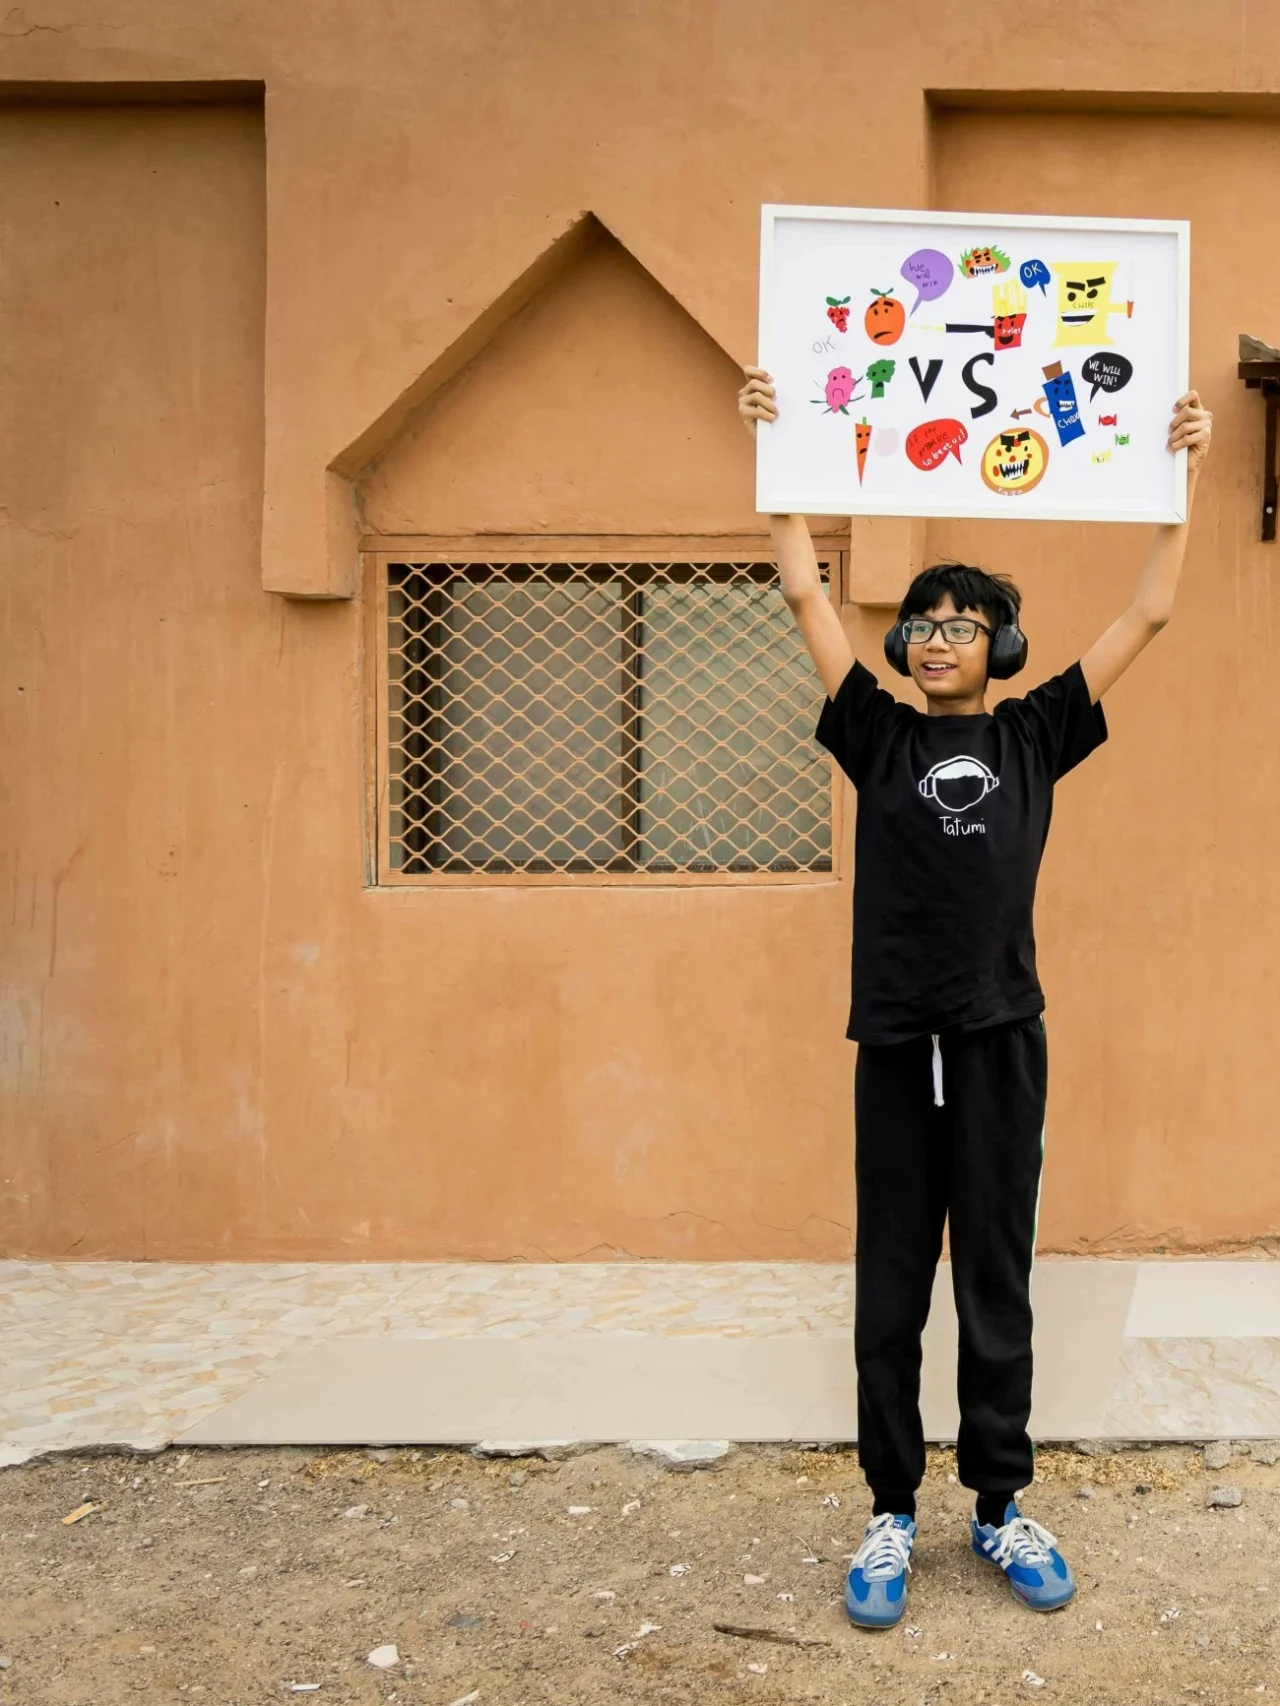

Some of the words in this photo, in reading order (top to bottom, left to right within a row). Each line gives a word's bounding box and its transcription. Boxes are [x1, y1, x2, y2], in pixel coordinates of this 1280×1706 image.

[1088, 359, 1101, 371] WE
[1102, 363, 1121, 376] WILL
[1093, 373, 1118, 387] WIN!
[938, 816, 986, 836] Tatumi
